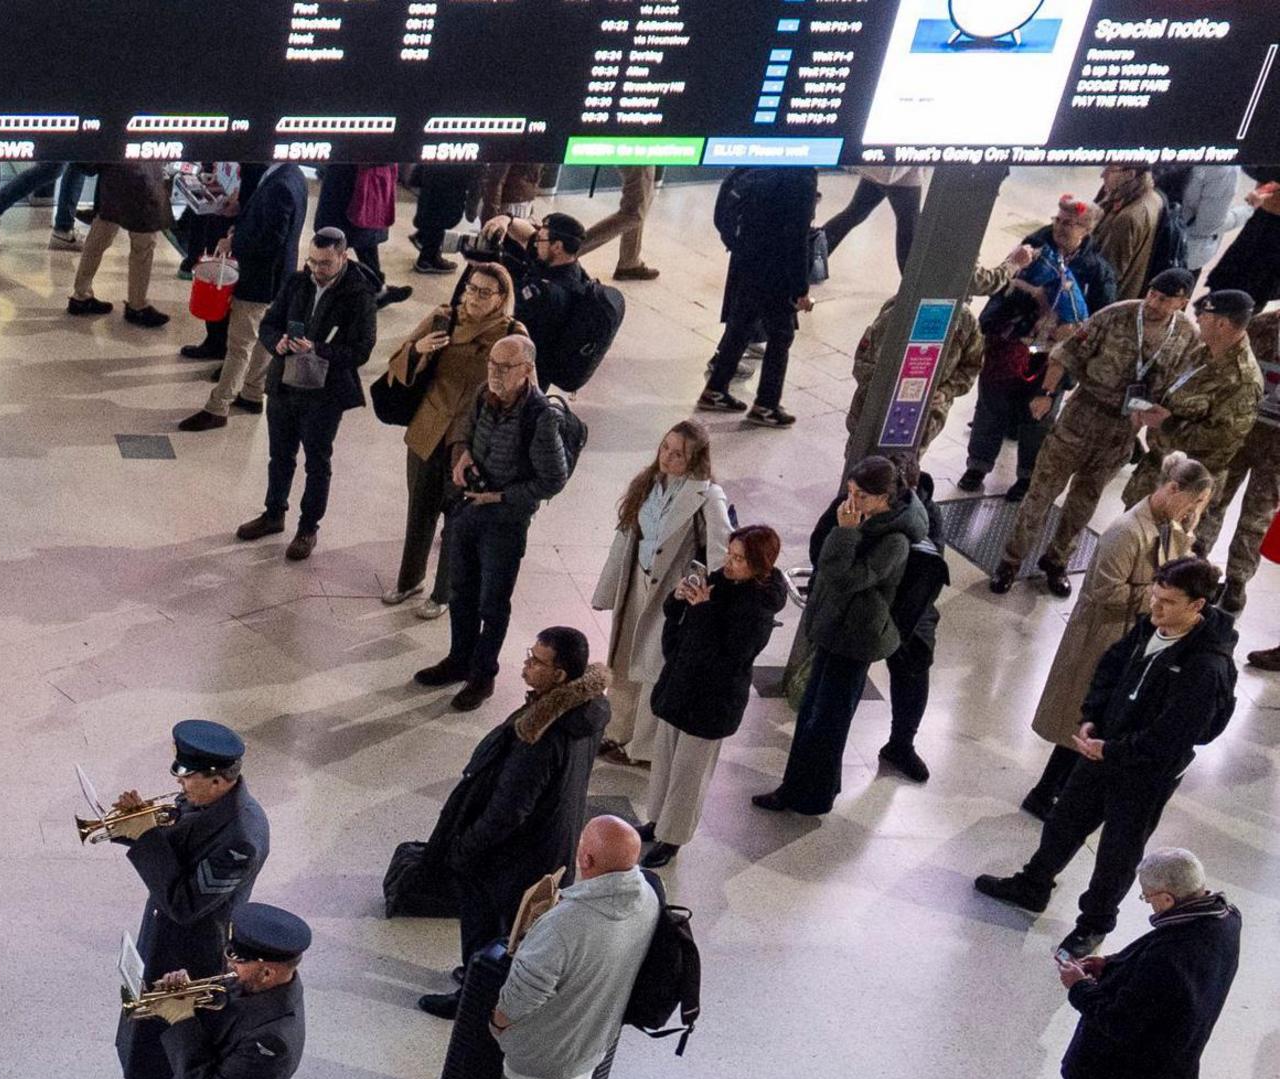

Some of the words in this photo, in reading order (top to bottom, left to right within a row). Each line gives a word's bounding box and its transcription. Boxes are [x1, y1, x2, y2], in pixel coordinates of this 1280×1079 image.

[1095, 18, 1168, 41] Special
[1168, 17, 1230, 38] notice
[140, 142, 183, 158] SWR
[290, 142, 331, 159] SWR
[440, 143, 479, 160] SWR
[942, 147, 984, 164] Going
[1012, 147, 1046, 162] Train
[1047, 147, 1105, 162] services
[1105, 147, 1160, 163] running
